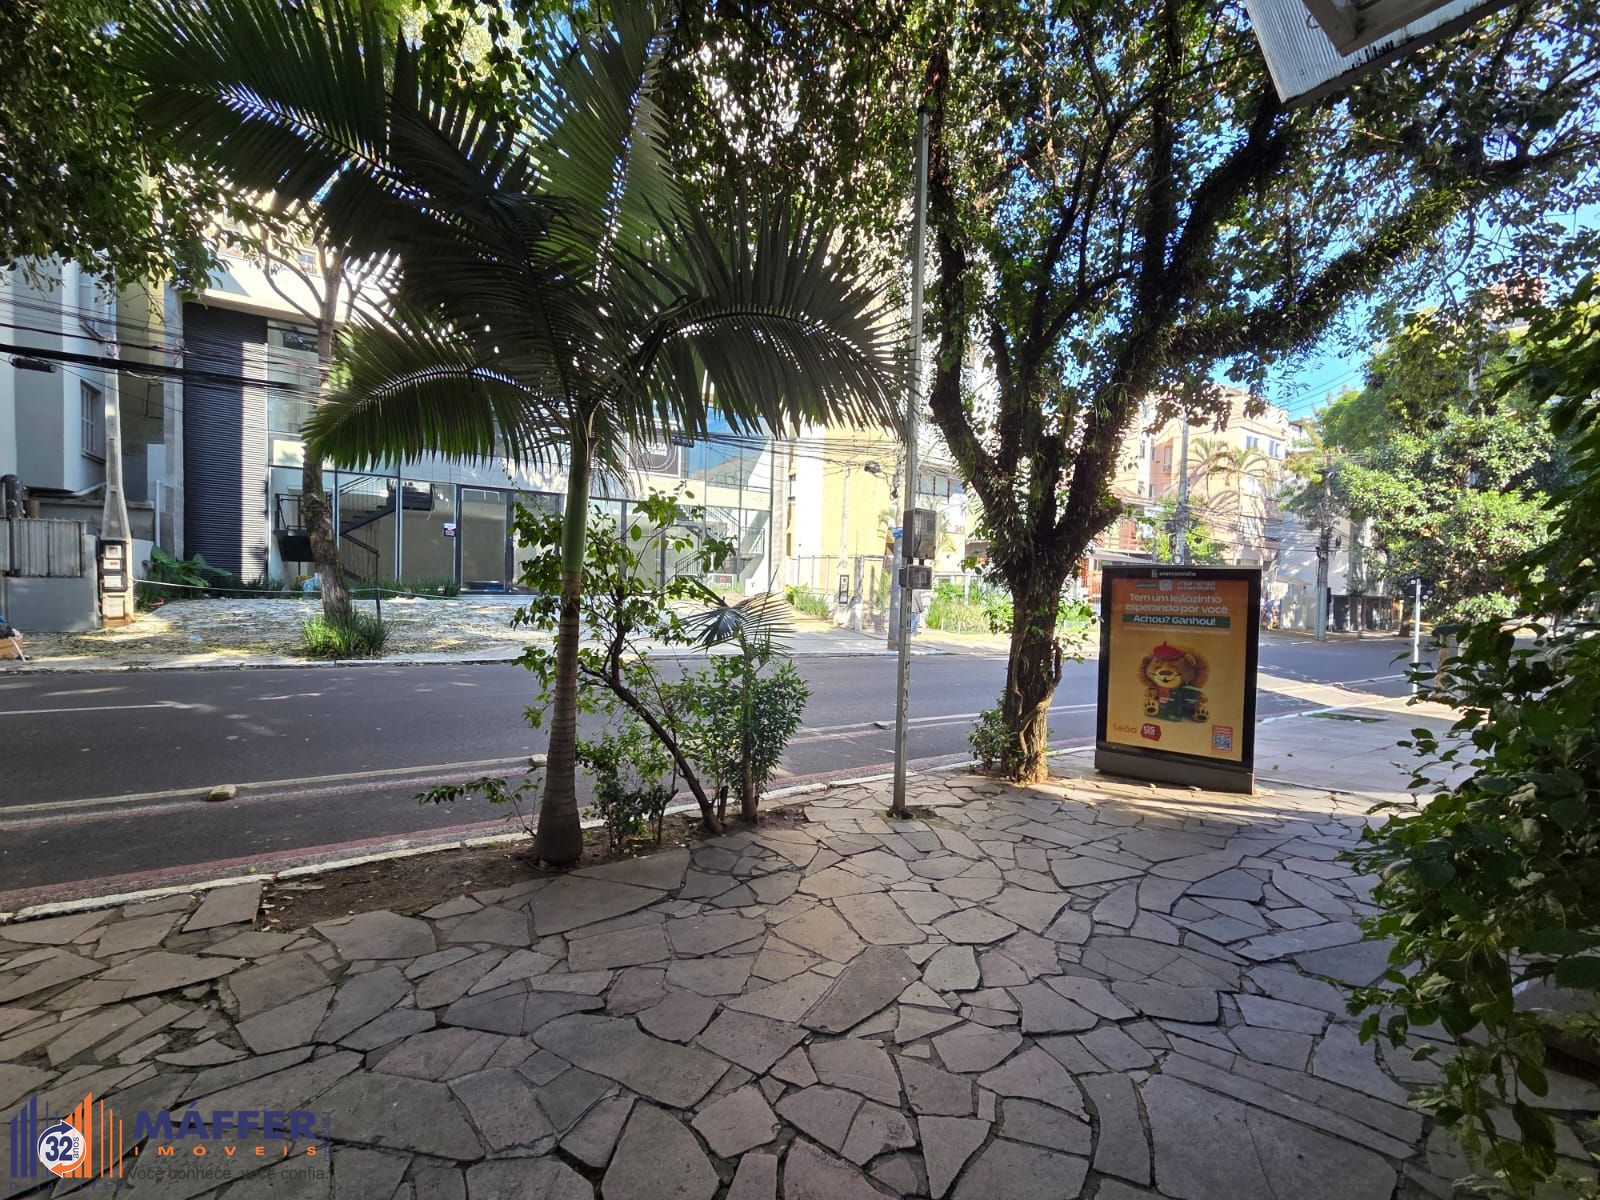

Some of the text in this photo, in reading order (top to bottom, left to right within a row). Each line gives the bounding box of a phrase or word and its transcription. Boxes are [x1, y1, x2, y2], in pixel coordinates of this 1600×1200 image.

[1129, 593, 1150, 602] Tem
[1152, 594, 1168, 602] um
[1125, 604, 1229, 614] esperando por você
[1133, 615, 1217, 625] Achou? Ganhou!
